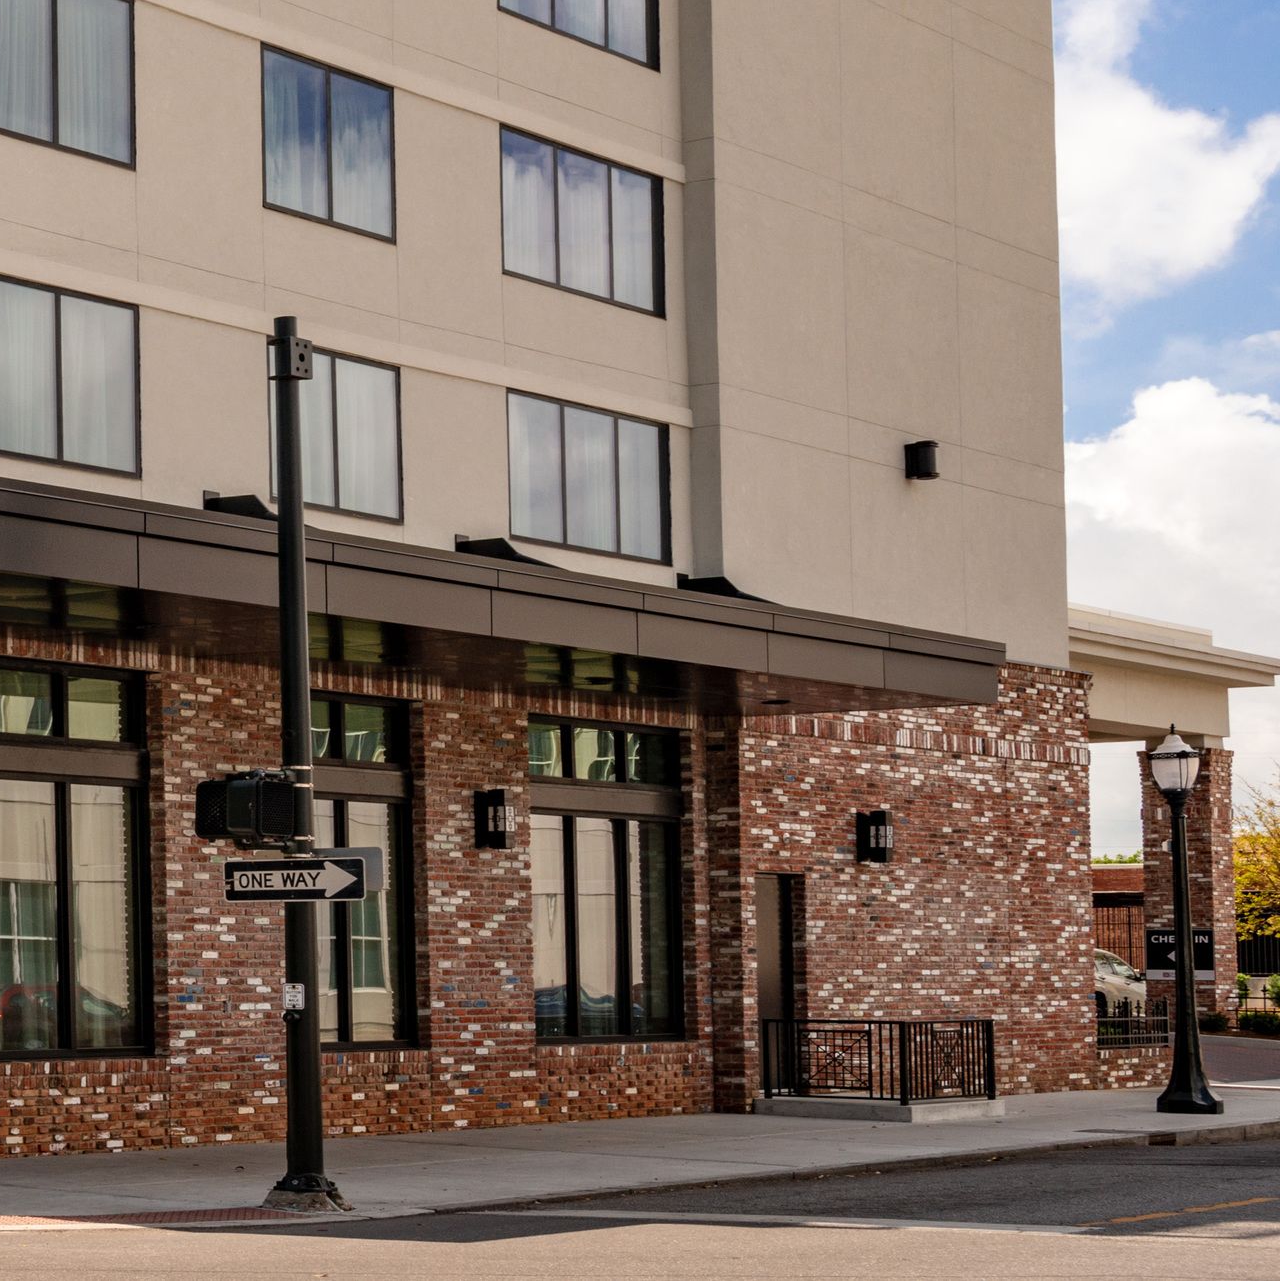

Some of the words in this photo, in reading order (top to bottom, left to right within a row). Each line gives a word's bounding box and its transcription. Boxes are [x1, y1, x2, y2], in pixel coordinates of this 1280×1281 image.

[239, 872, 274, 889] ONE
[281, 871, 321, 888] WAY
[1151, 935, 1176, 944] CHE
[1194, 935, 1209, 944] IN
